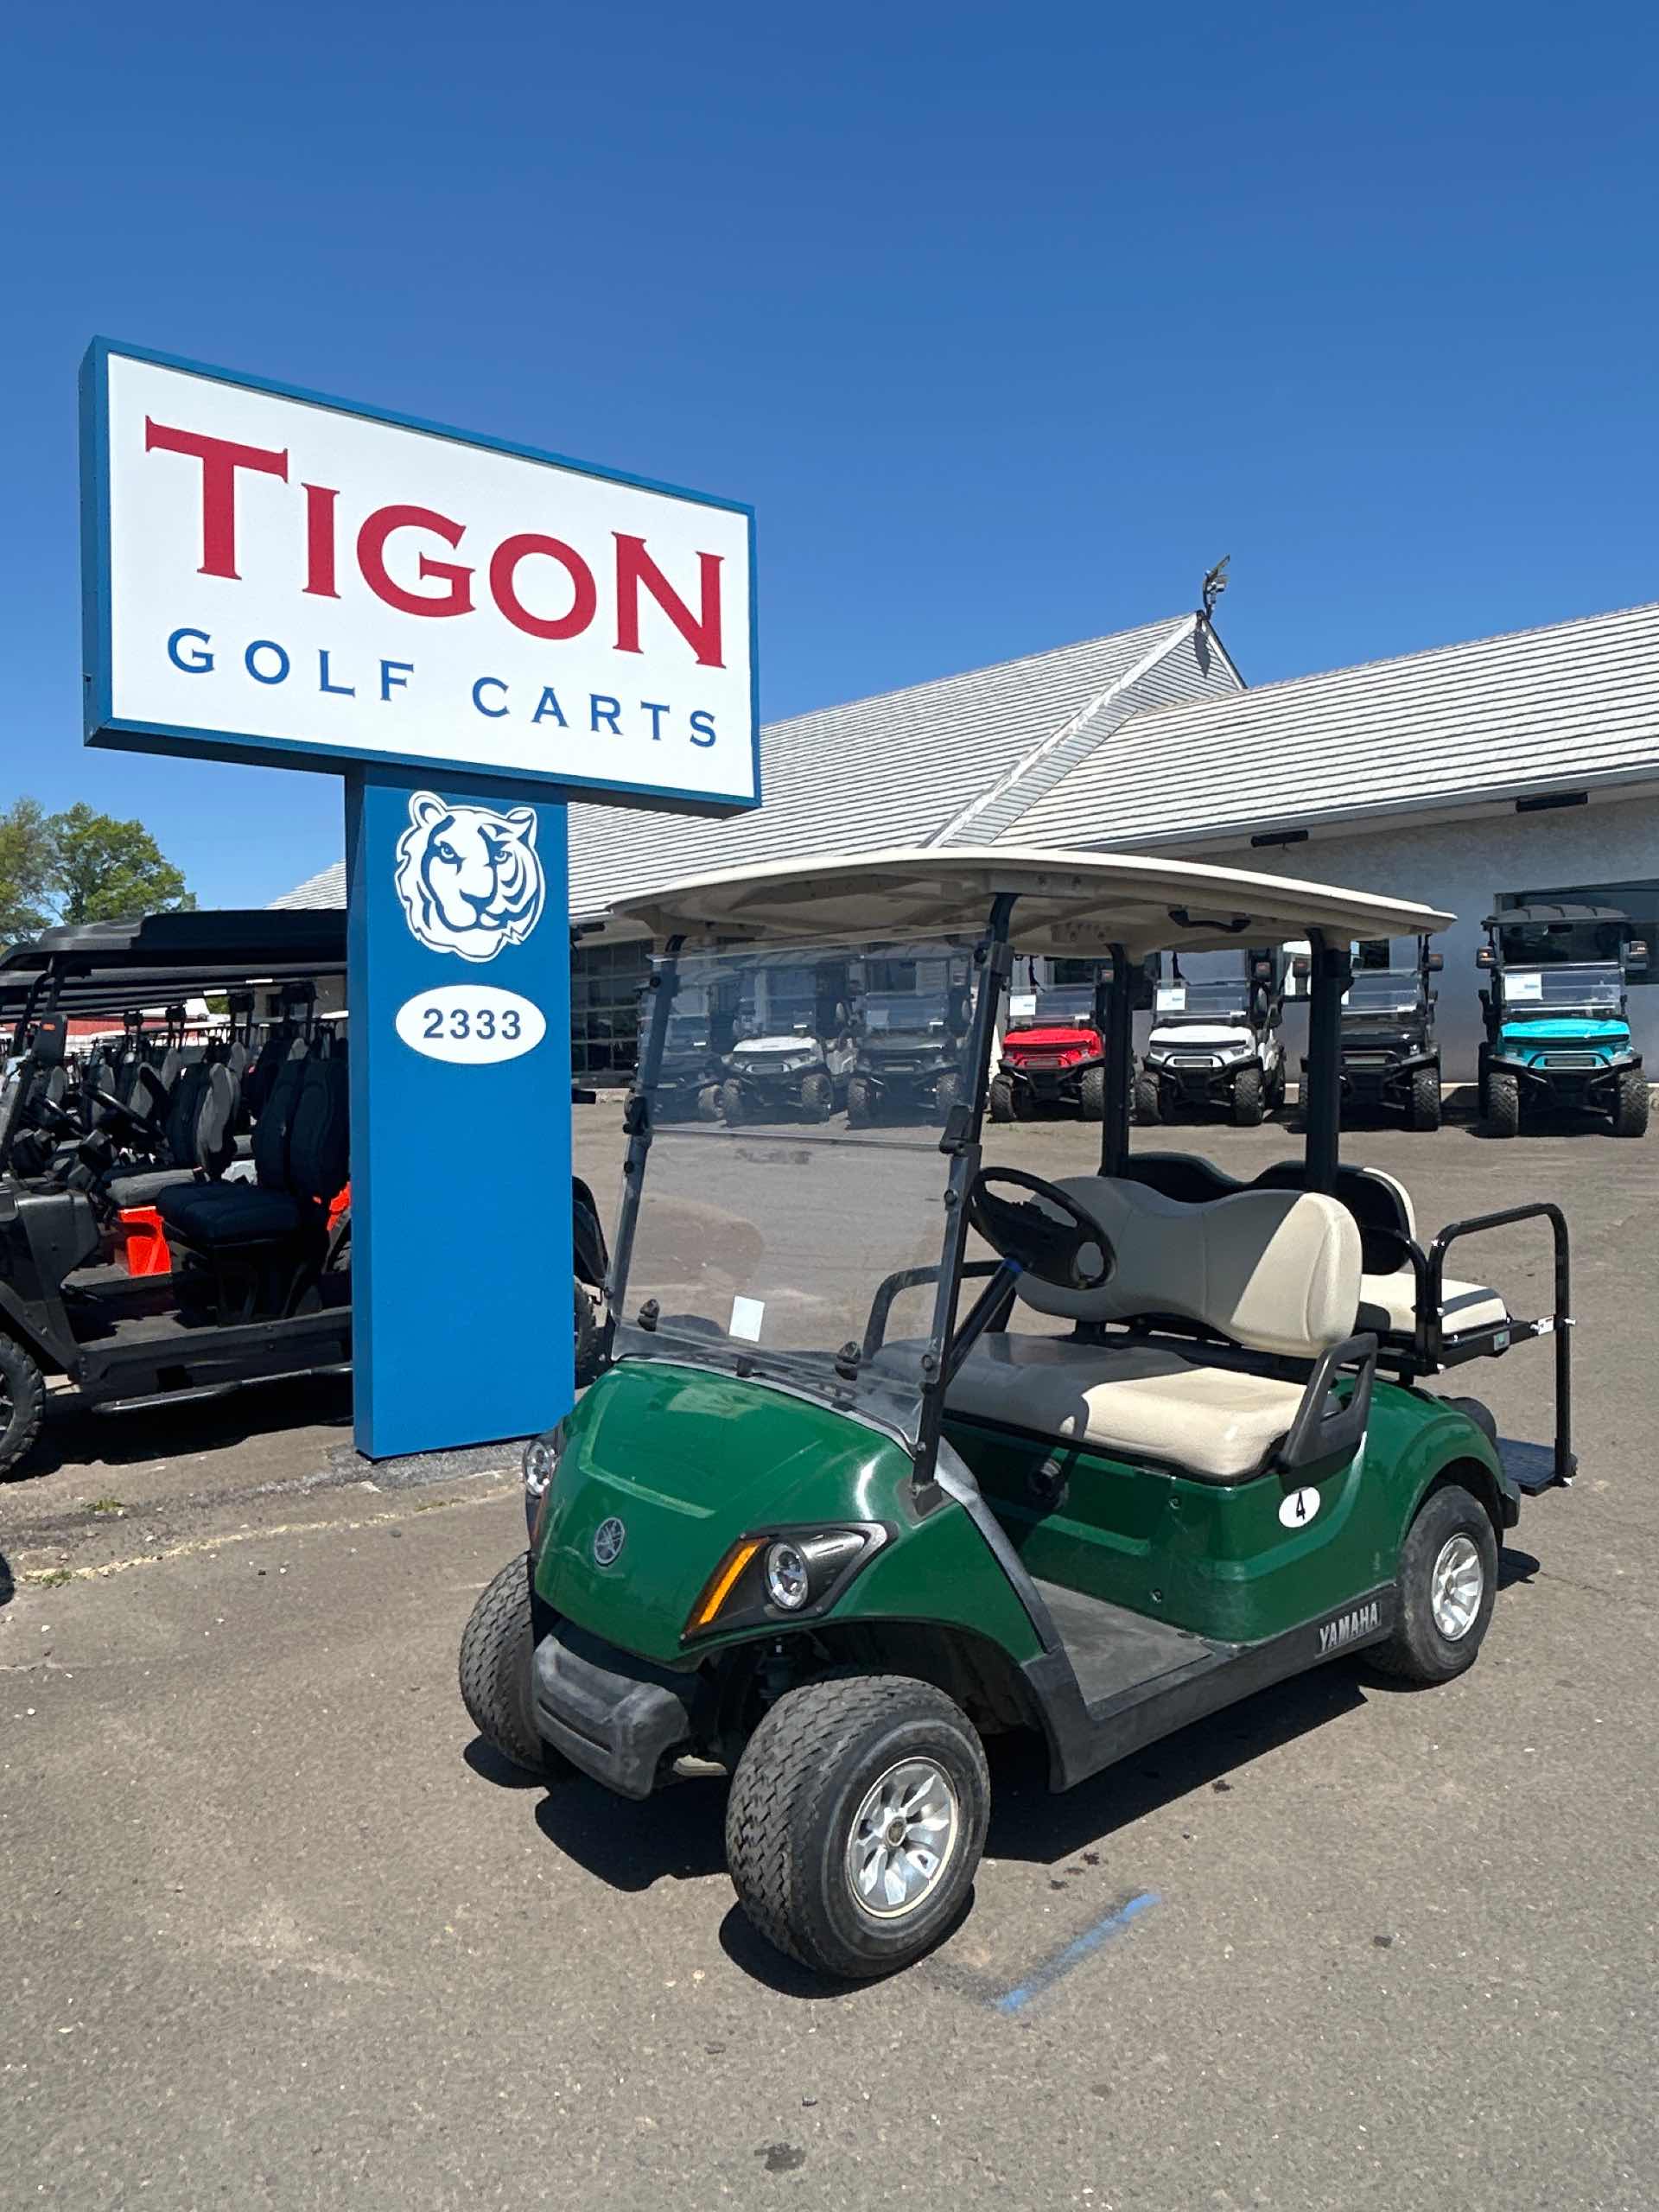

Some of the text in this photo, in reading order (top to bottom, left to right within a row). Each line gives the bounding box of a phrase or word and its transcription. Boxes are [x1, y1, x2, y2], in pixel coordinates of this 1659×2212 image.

[145, 415, 727, 668] TIGON
[167, 627, 716, 747] GOLF CARTS
[423, 1008, 522, 1040] 2333
[1296, 1491, 1306, 1521] 4
[1319, 1602, 1378, 1652] YAMAHA
